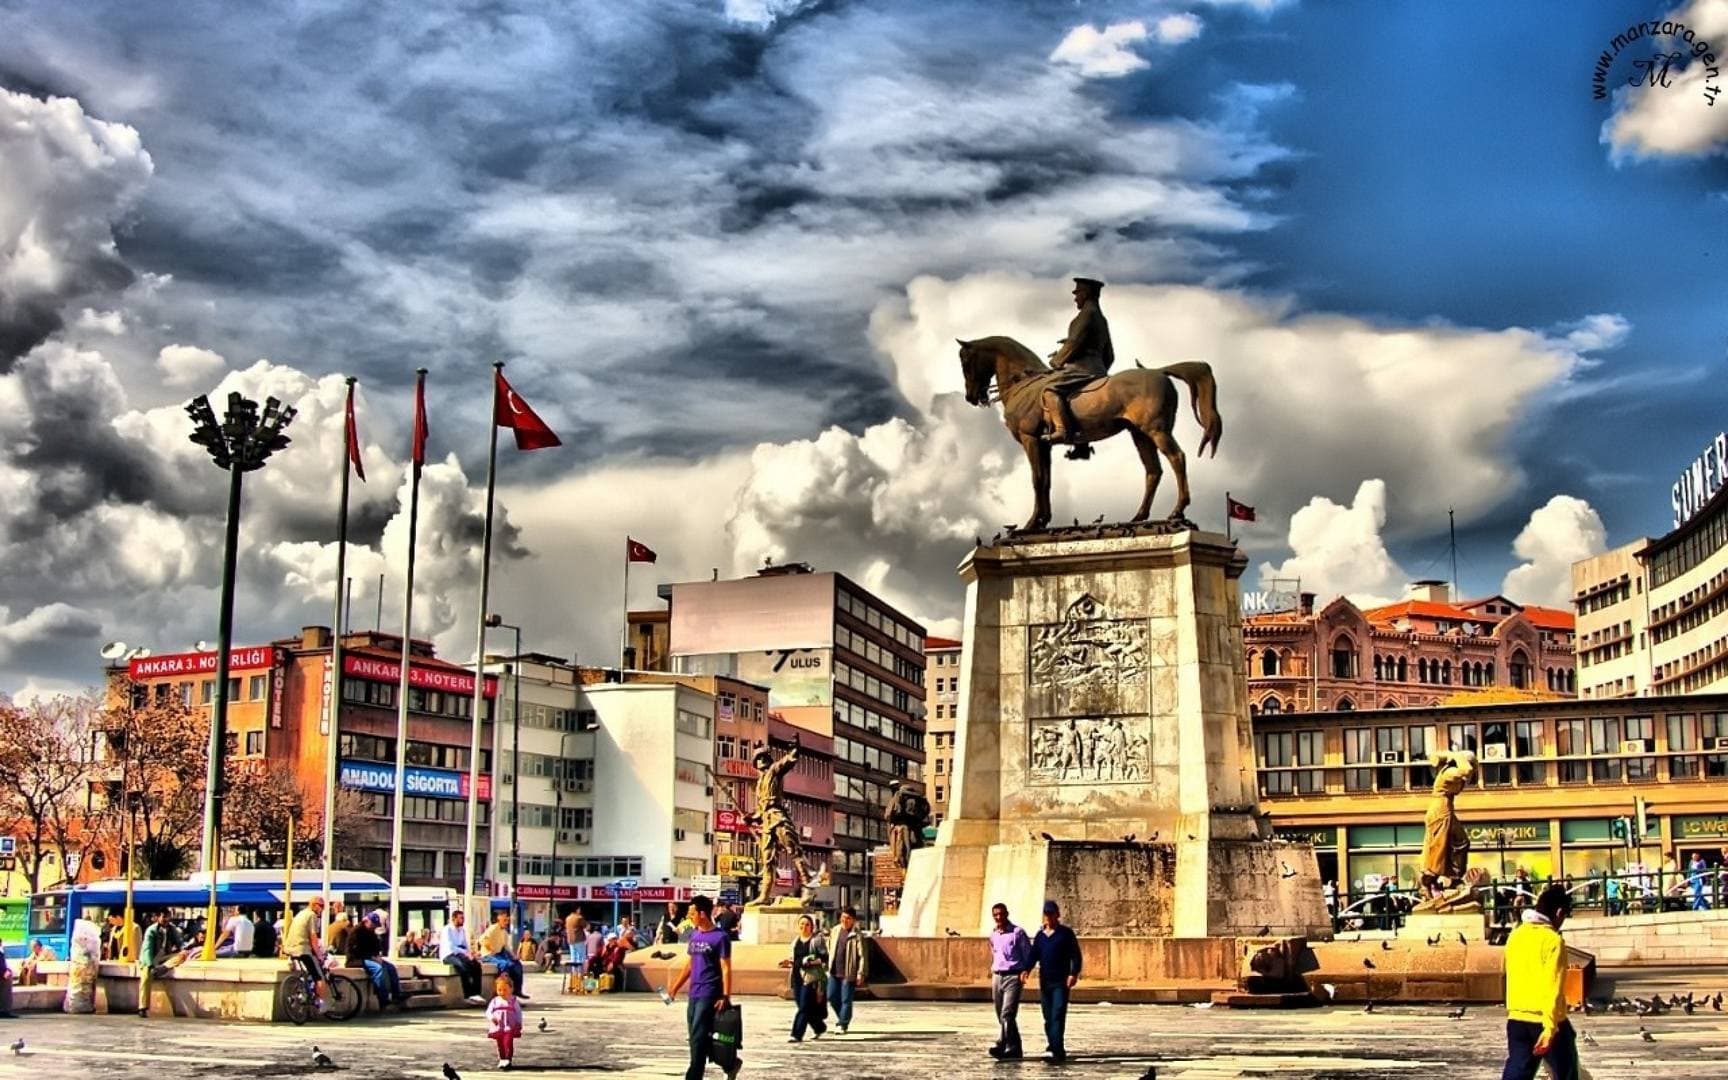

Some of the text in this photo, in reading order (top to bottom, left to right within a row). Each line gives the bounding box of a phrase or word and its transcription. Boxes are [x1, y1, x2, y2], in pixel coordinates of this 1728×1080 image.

[136, 650, 265, 674] ANKARA 3. NORLİĞİ
[790, 657, 821, 669] ULUS
[352, 660, 490, 692] ANKAR 3. NOTERLİ
[340, 768, 402, 789] ANADOL
[406, 770, 459, 794] SİGORTA
